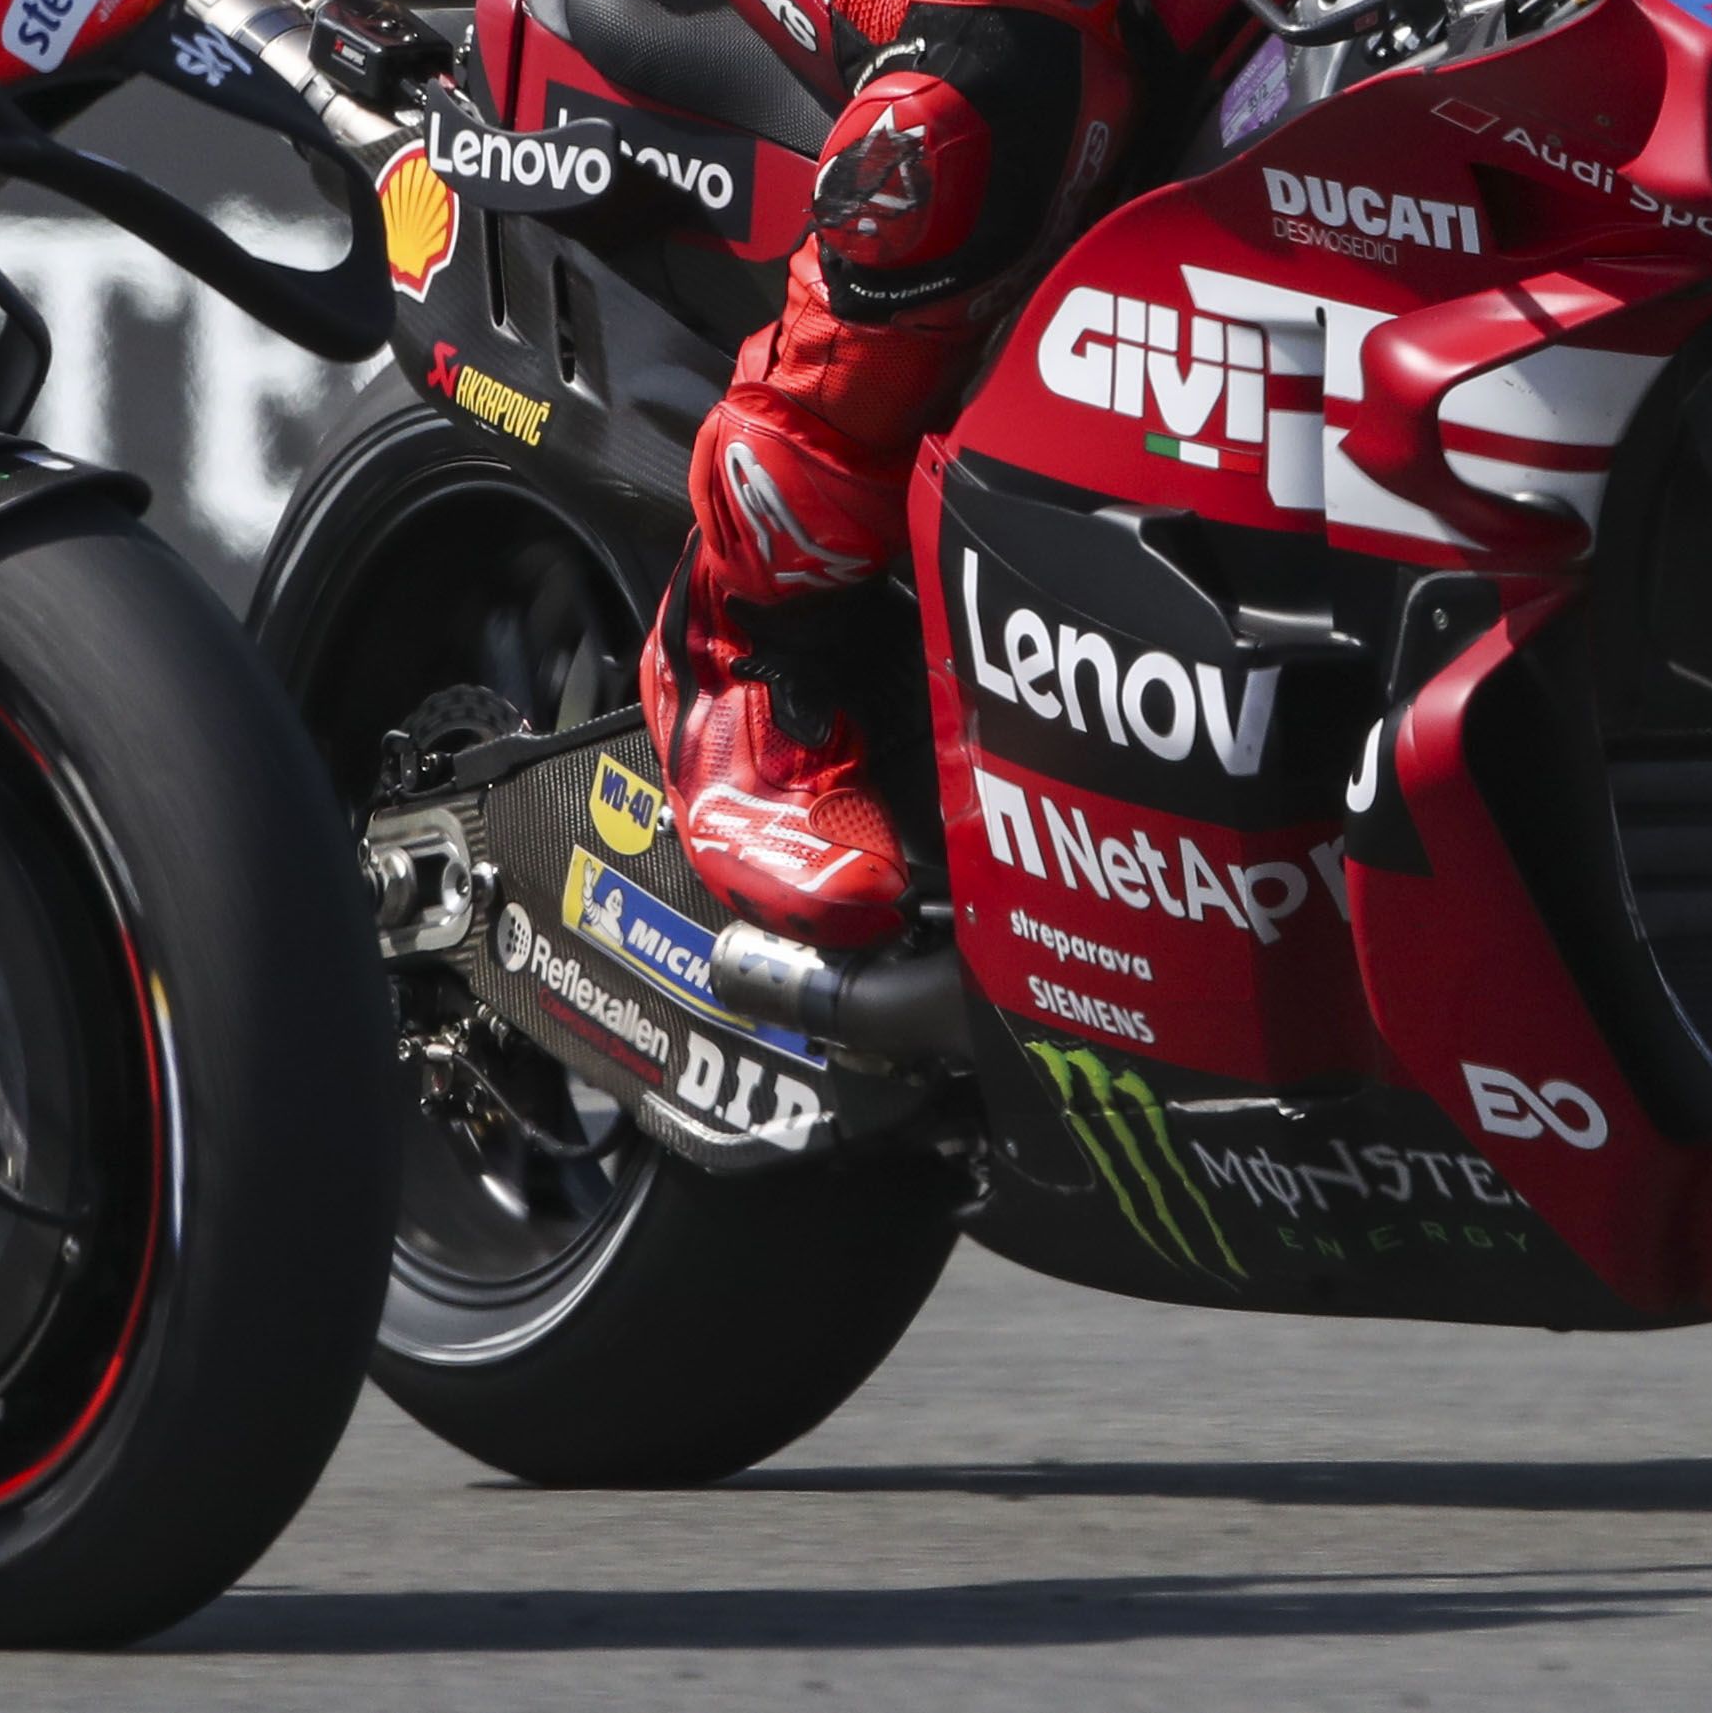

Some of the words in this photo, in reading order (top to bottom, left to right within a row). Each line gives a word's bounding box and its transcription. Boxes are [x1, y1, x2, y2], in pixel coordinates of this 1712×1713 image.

[430, 111, 613, 196] Lenovo
[1503, 125, 1616, 196] Audi
[1262, 167, 1482, 255] DUCATI
[1272, 217, 1401, 267] DESMOSEDICI
[960, 547, 1282, 778] Lenov
[599, 767, 656, 835] WD-40
[1011, 907, 1154, 981] streparava
[531, 932, 671, 1063] Reflexallen
[1027, 974, 1157, 1045] SIEMENS
[1189, 1136, 1530, 1221] MONSTE
